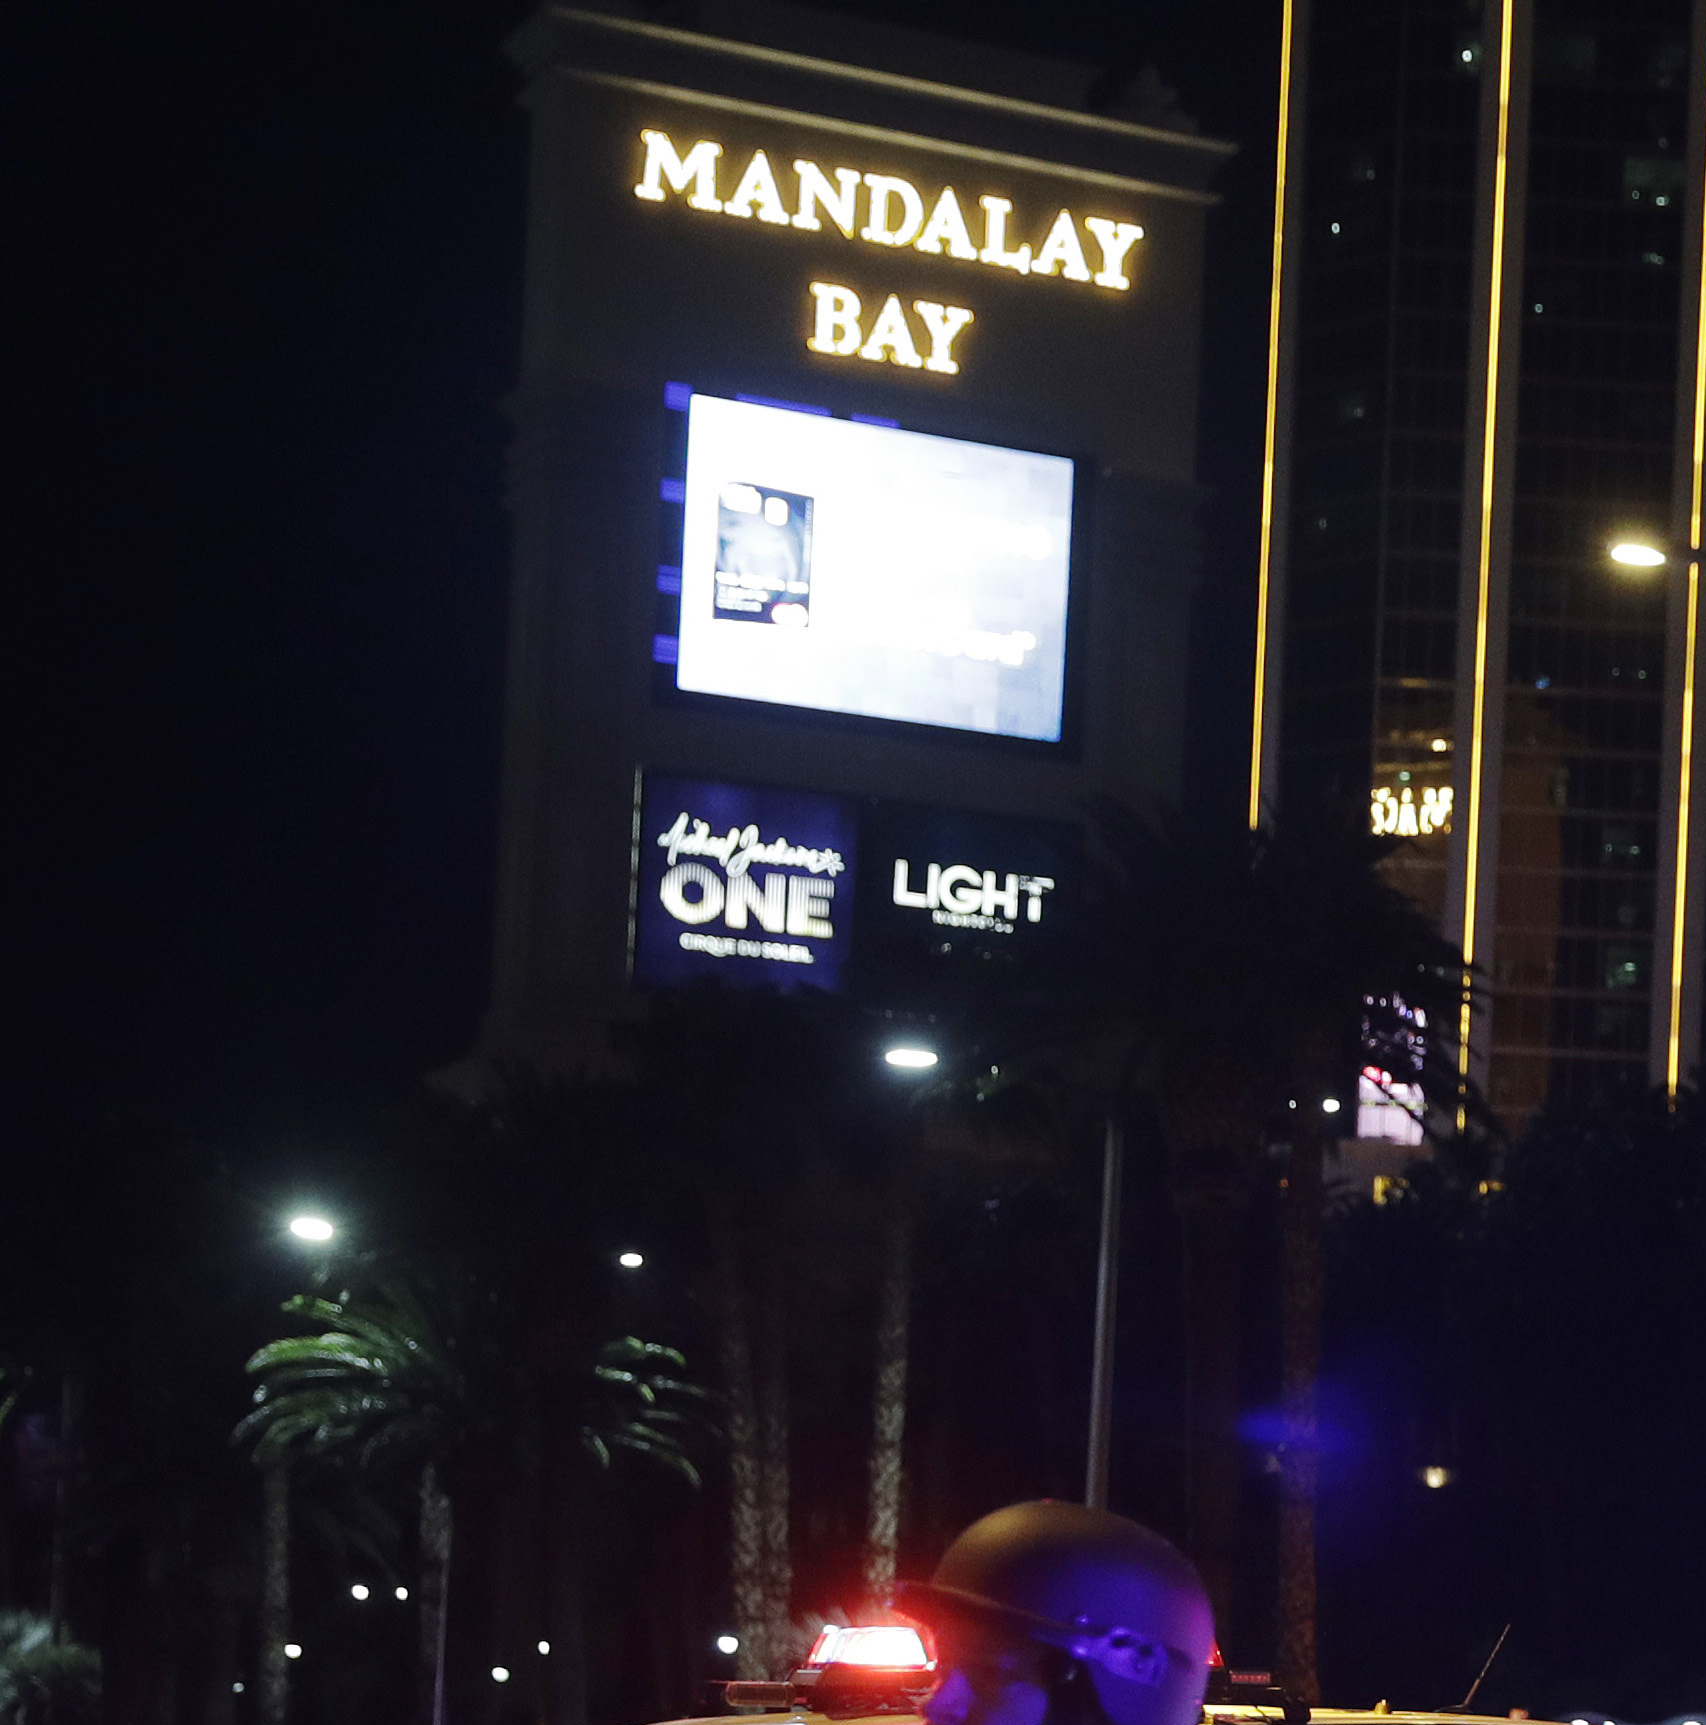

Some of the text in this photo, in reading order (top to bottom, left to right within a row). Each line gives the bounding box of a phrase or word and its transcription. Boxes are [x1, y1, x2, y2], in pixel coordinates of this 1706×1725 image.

[635, 128, 1143, 291] MANDALAY
[807, 281, 974, 374] BAY
[660, 862, 834, 938] ONE
[893, 859, 1055, 922] LIGHT
